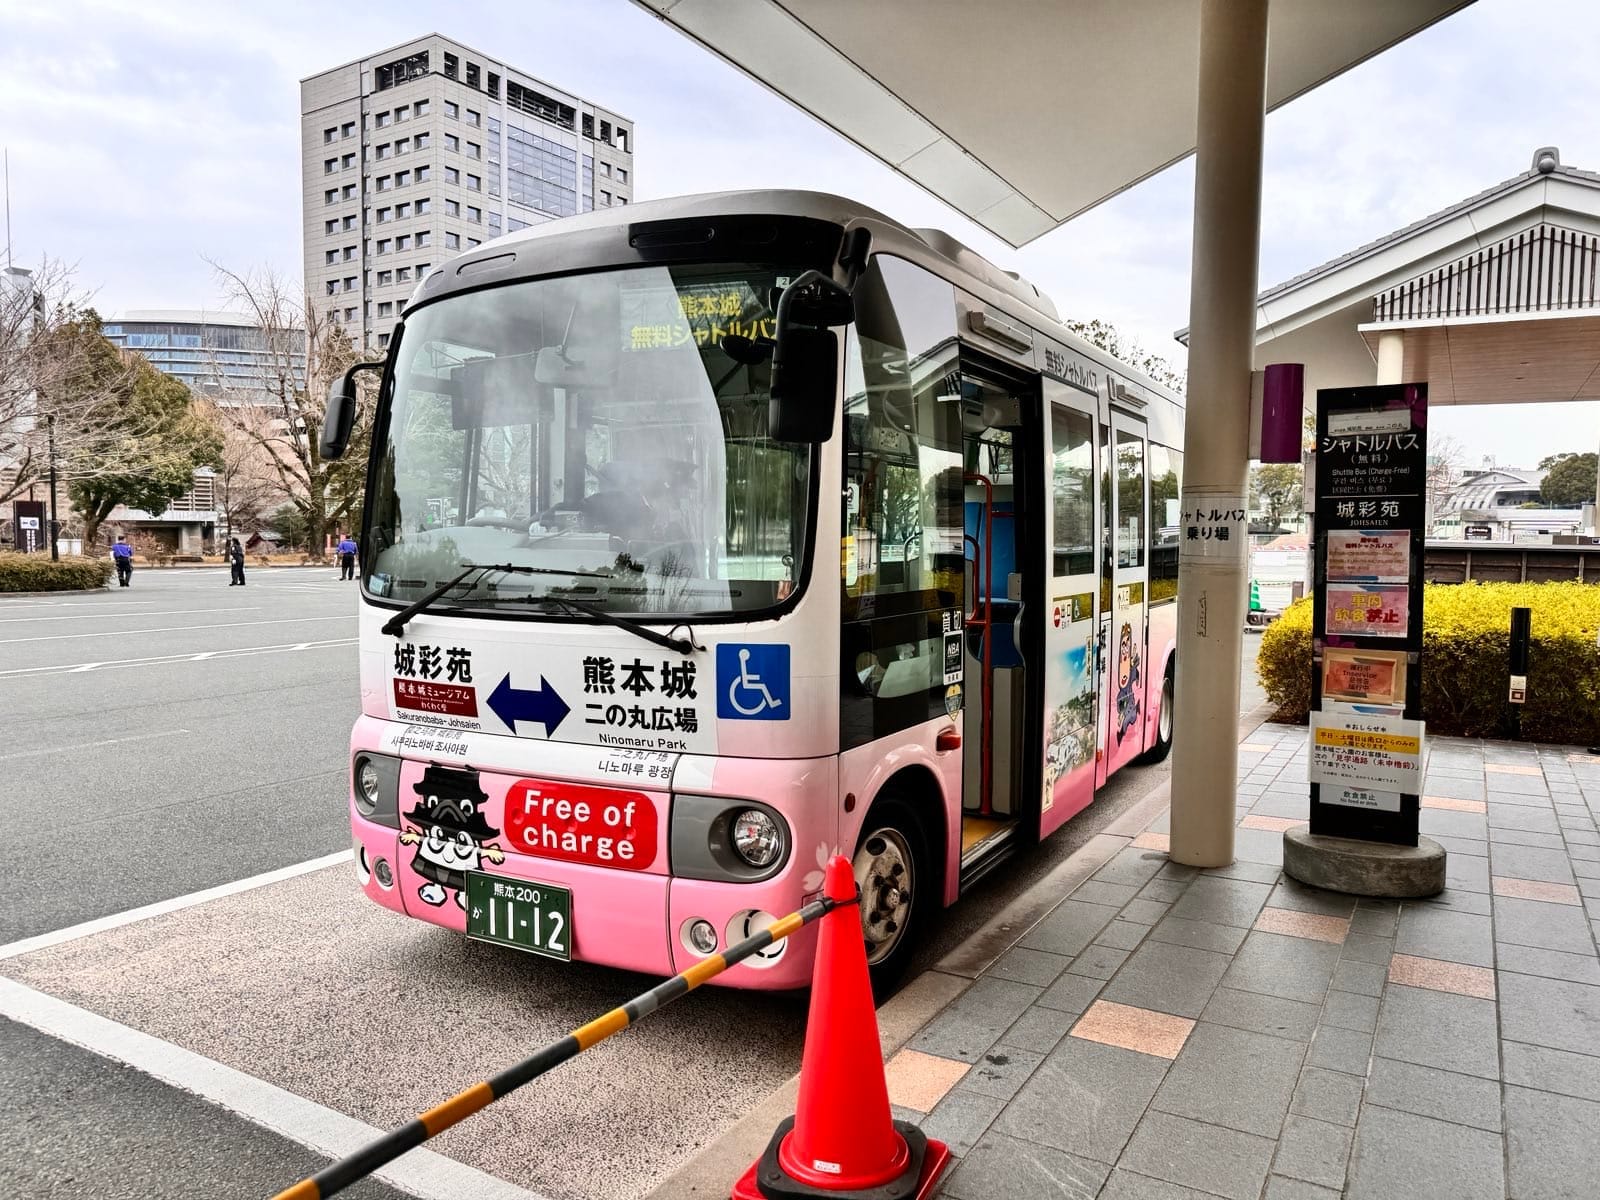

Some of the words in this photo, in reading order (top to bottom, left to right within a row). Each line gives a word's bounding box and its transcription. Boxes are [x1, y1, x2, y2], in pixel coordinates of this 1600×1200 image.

[678, 292, 742, 318] 熊本城
[1322, 433, 1419, 453] シャトルバス
[1181, 509, 1245, 523] ャトルバス
[1337, 501, 1400, 518] 城彩苑
[1187, 526, 1229, 540] 乗り場
[1351, 593, 1382, 608] 車内
[1335, 608, 1399, 623] 飲食禁止
[394, 642, 473, 683] 城彩苑
[582, 656, 698, 700] 熊本城
[398, 681, 470, 700] 熊本城ミュージアム
[585, 703, 698, 733] 二の丸広場
[599, 733, 654, 748] Ninomaru
[658, 738, 687, 750] Park
[598, 760, 644, 776] 니노마루
[648, 765, 673, 779] 광장
[524, 789, 591, 822] Free
[603, 801, 636, 827] of
[523, 823, 635, 860] charge
[472, 906, 483, 919] か
[489, 897, 564, 952] 11-12
